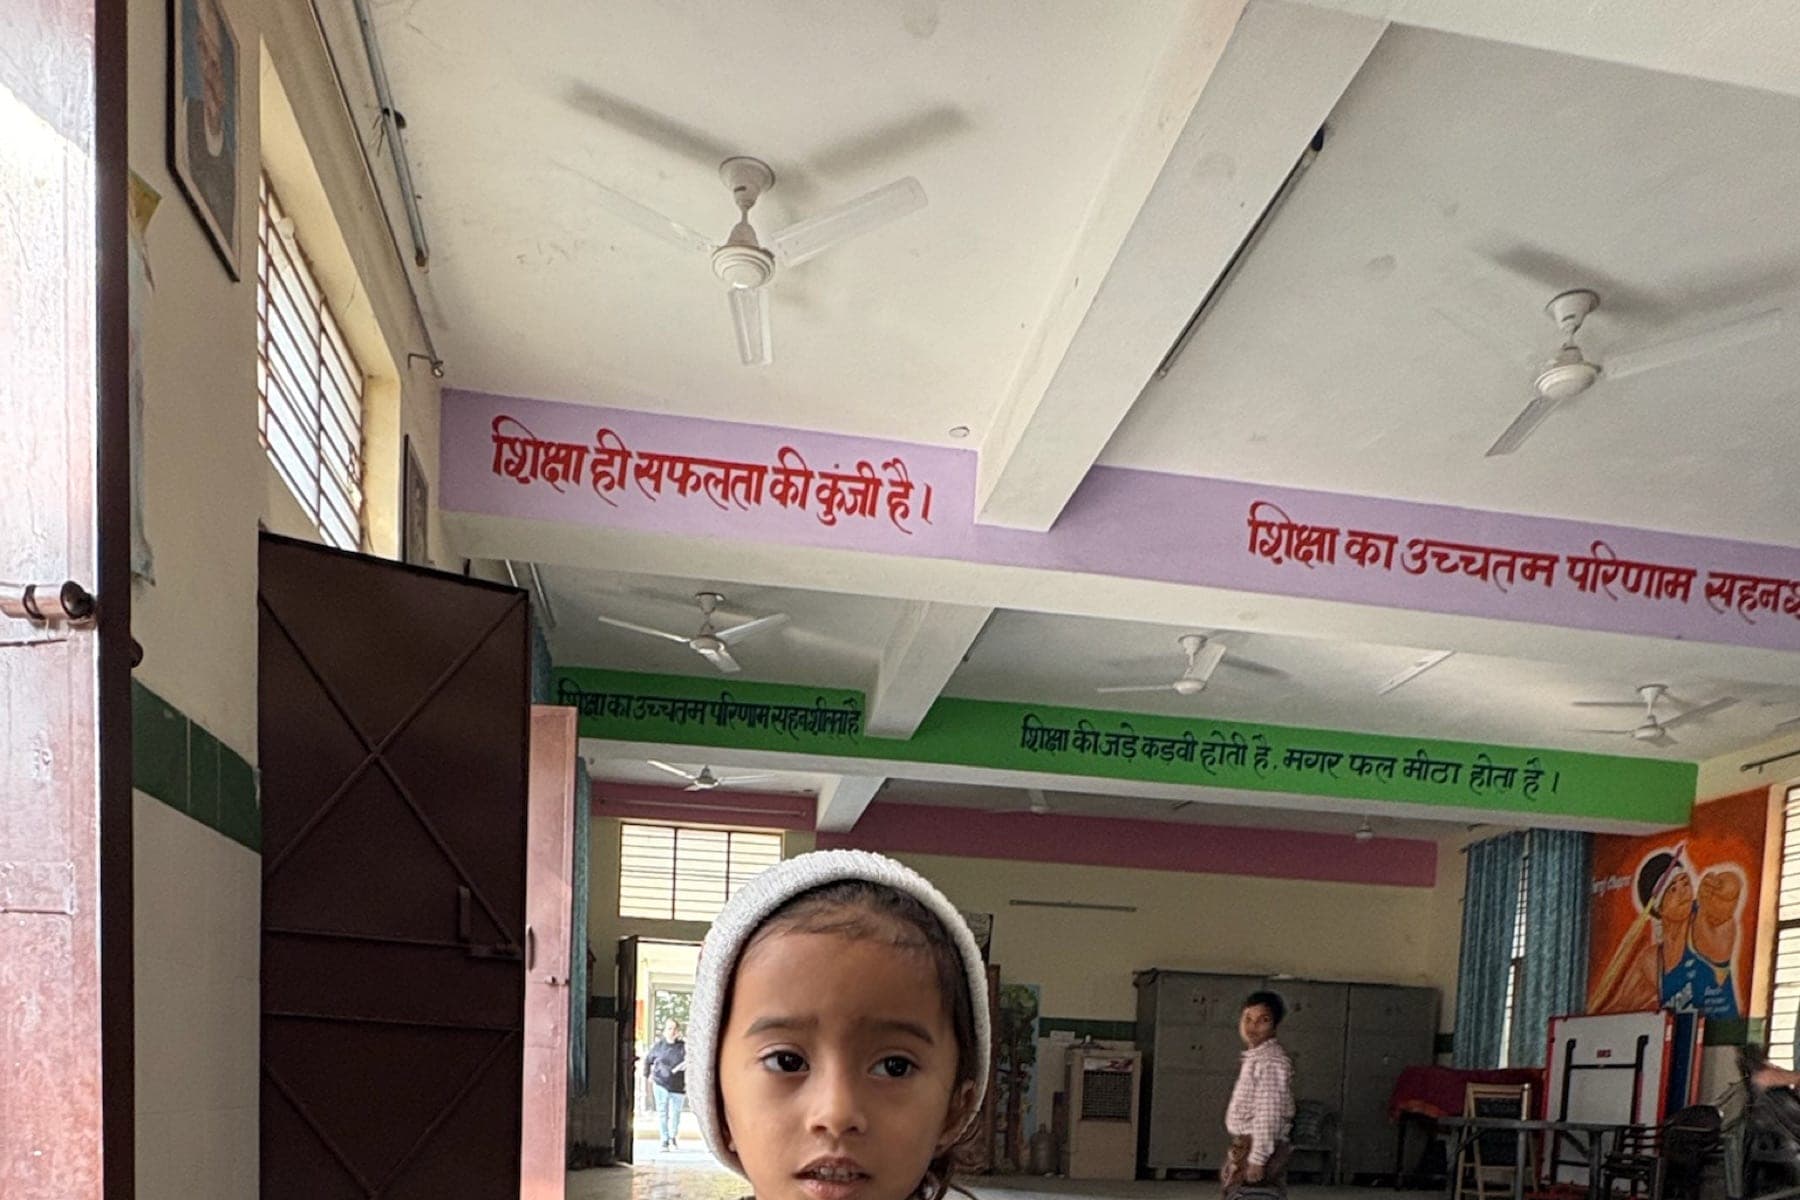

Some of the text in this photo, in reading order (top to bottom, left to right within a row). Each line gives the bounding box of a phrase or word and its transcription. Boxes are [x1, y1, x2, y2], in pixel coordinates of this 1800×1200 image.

[491, 415, 589, 493] शिक्षा
[590, 428, 632, 507] ही
[634, 451, 767, 510] सफलता
[768, 446, 815, 510] की
[816, 461, 883, 526] कुंजी
[1247, 501, 1340, 568] शिक्षा
[1345, 530, 1398, 571] का
[1401, 538, 1559, 592] उच्चतम
[1567, 540, 1697, 604] परिणाम
[607, 694, 634, 718] का
[633, 696, 706, 725] उच्चतम
[706, 691, 771, 730] परिणाम
[1020, 714, 1070, 756] शिक्षा
[1072, 720, 1101, 755] की
[1201, 730, 1249, 776] होती
[1283, 748, 1343, 779] मगर
[1350, 754, 1397, 784] फल
[1403, 749, 1462, 785] मीठा
[1469, 753, 1518, 796] होता
